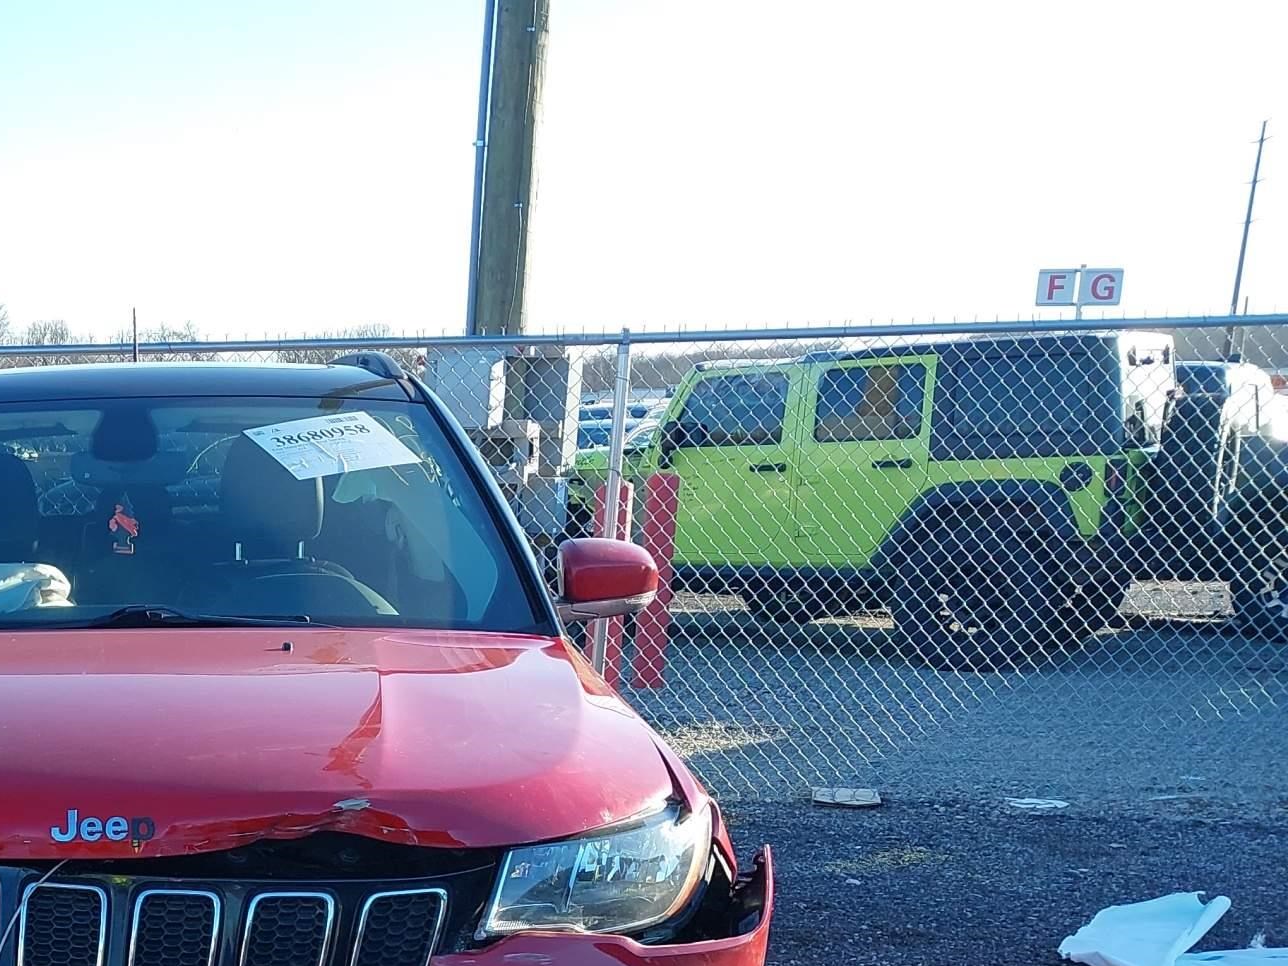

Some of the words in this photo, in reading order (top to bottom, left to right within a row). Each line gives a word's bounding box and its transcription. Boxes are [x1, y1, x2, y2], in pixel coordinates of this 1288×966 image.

[1047, 274, 1067, 300] F
[1091, 273, 1116, 300] G
[270, 423, 370, 448] 38680958
[50, 809, 155, 848] Jeep
